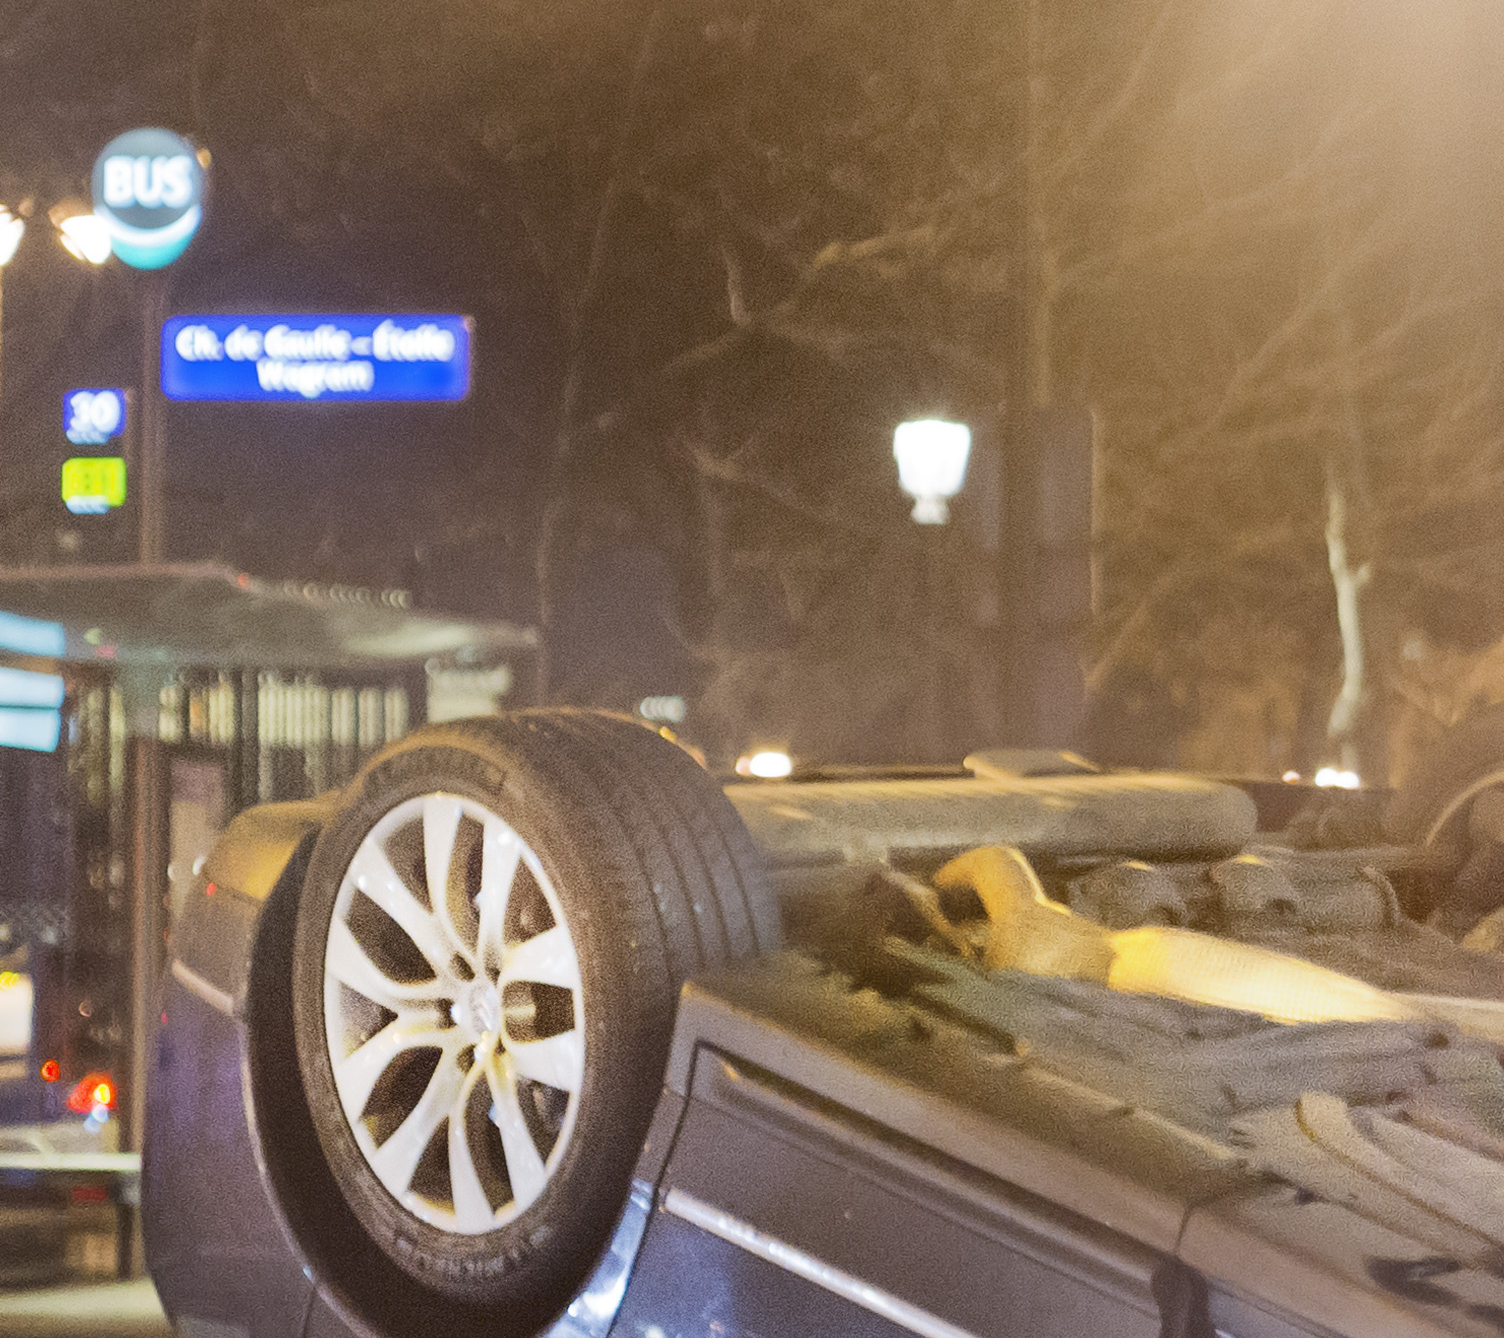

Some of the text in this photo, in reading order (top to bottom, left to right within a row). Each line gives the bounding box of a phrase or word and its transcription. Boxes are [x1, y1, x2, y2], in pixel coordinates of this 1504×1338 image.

[103, 155, 194, 208] BUS
[224, 324, 263, 361] de
[264, 323, 351, 361] Gaulle
[256, 358, 375, 398] Wagram
[70, 391, 119, 432] 30
